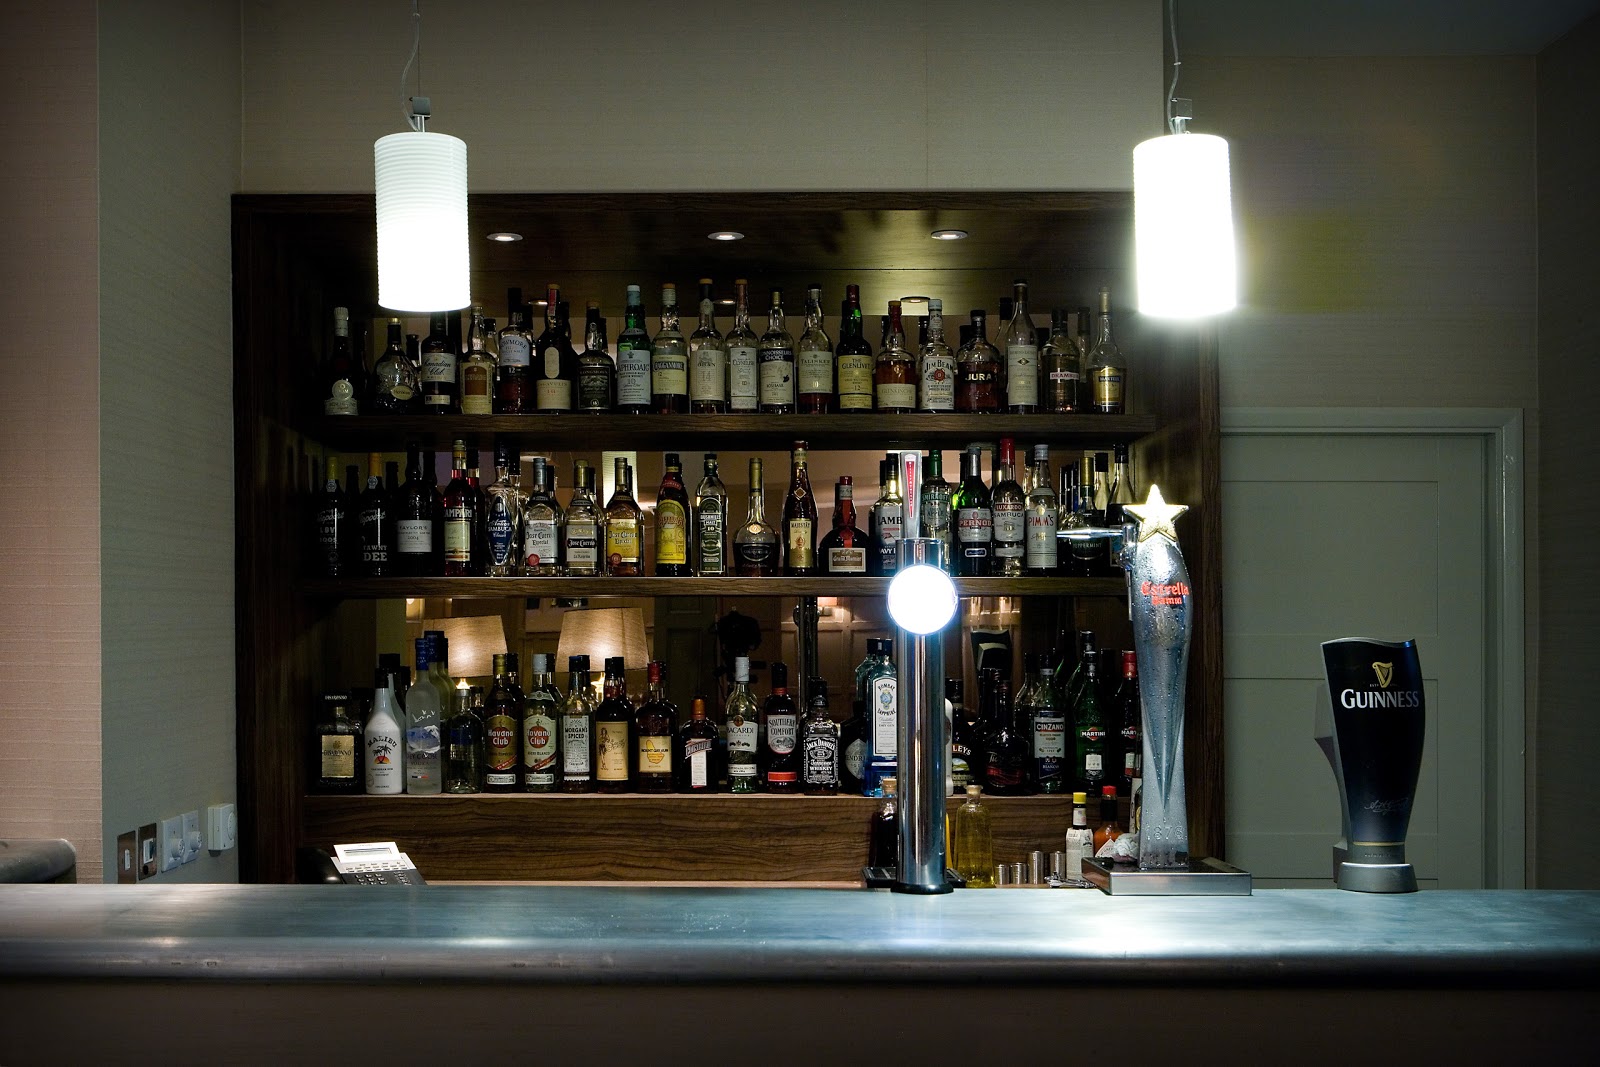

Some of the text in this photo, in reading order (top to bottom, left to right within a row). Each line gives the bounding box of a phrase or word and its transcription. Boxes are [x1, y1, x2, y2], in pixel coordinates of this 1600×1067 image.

[423, 358, 452, 368] Canadian
[617, 363, 650, 372] APHROAIG
[841, 362, 872, 370] GLENLIVET
[925, 362, 936, 373] JIM
[965, 373, 993, 381] JURA
[444, 508, 473, 518] AMPARI
[1028, 514, 1054, 527] PIMM'S
[363, 552, 388, 562] DEE
[1141, 581, 1190, 596] Estrella
[878, 683, 896, 691] BOMBAY
[1340, 688, 1420, 709] GUINNESS
[768, 718, 796, 728] SOUTHERN
[487, 729, 514, 737] Havana
[526, 729, 552, 737] Havana
[770, 727, 794, 736] COMFORT
[367, 735, 398, 749] MALIBU
[492, 737, 509, 745] Club
[529, 737, 546, 745] Club
[806, 741, 818, 751] JACK
[952, 744, 972, 756] LEYS
